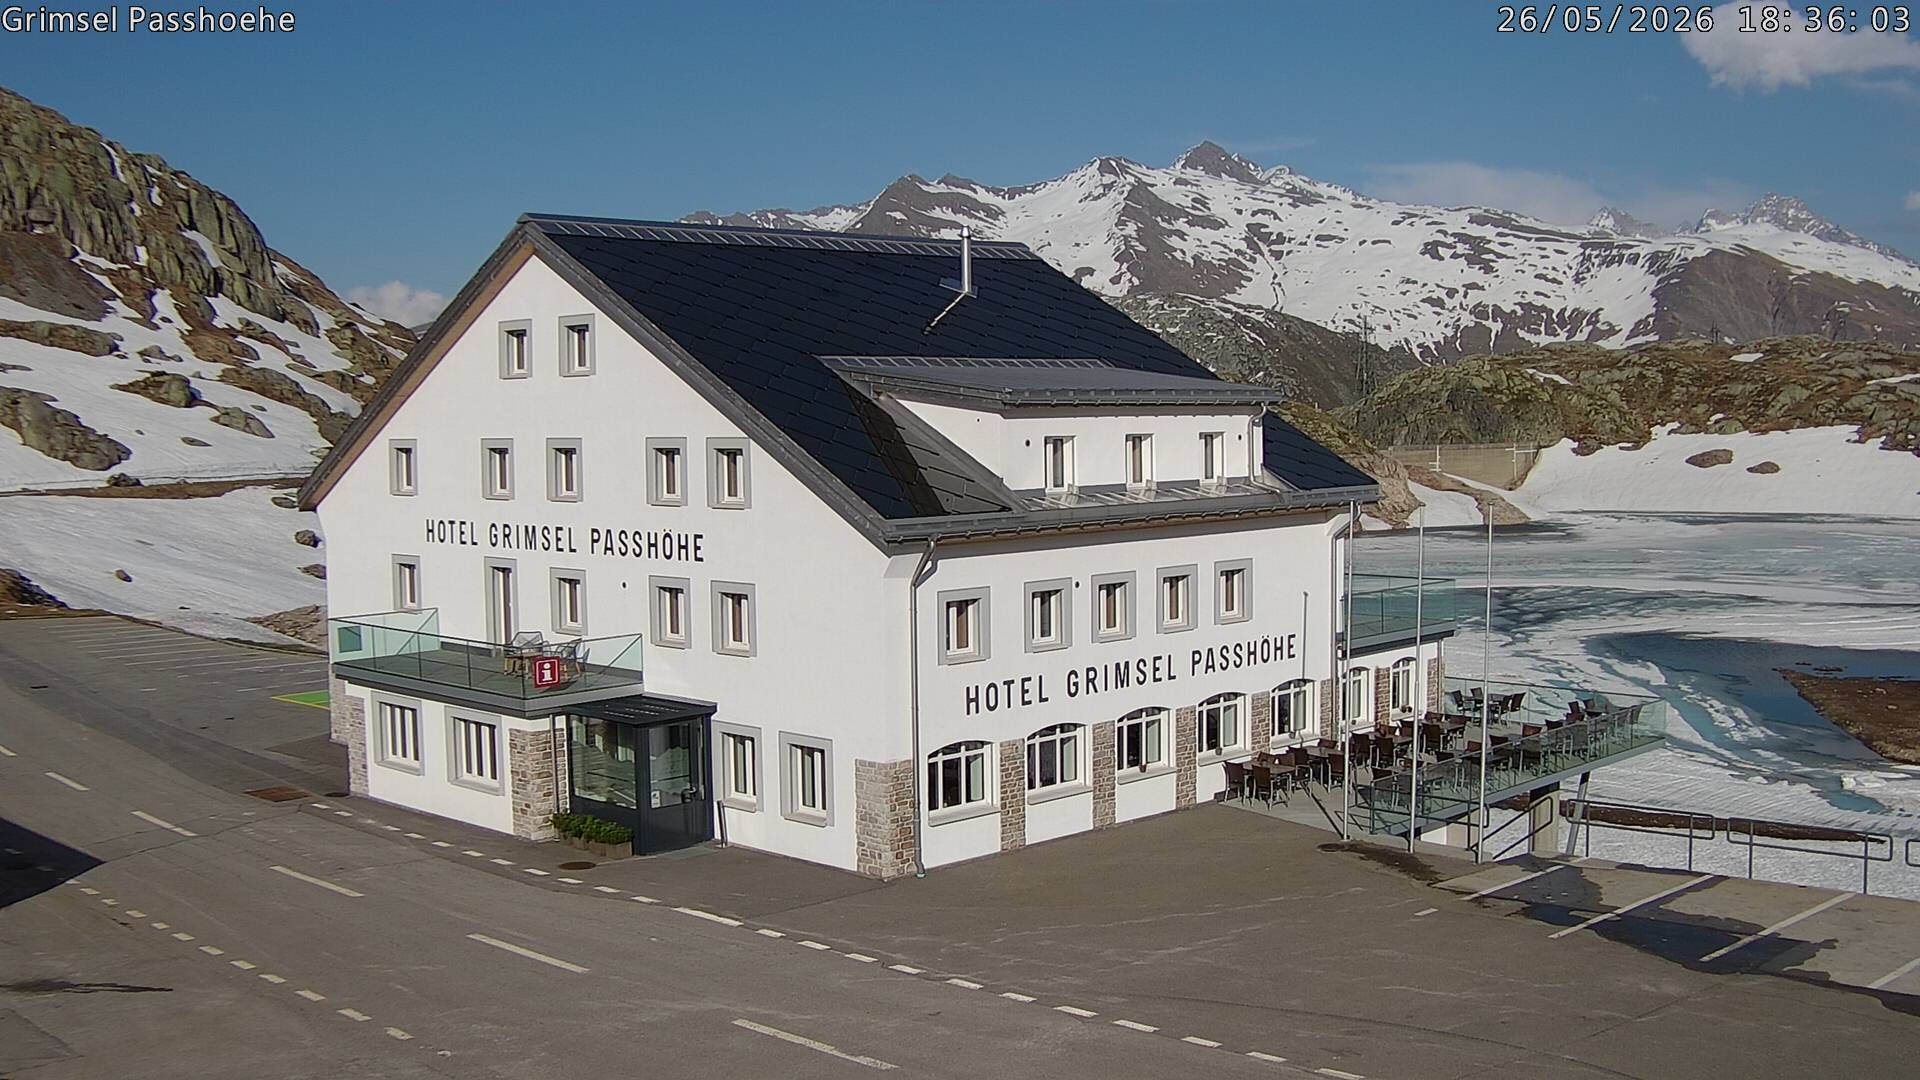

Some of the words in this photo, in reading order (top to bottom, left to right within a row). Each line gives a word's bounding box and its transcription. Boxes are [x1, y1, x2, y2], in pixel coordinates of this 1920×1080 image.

[426, 519, 478, 546] HOTEL
[489, 523, 577, 553] GRIMSEL
[590, 528, 704, 562] PASSHÖHE
[965, 675, 1049, 716] HOTEL
[1067, 654, 1176, 698] GRIMSEL
[1191, 633, 1297, 677] PASSHÖHE
